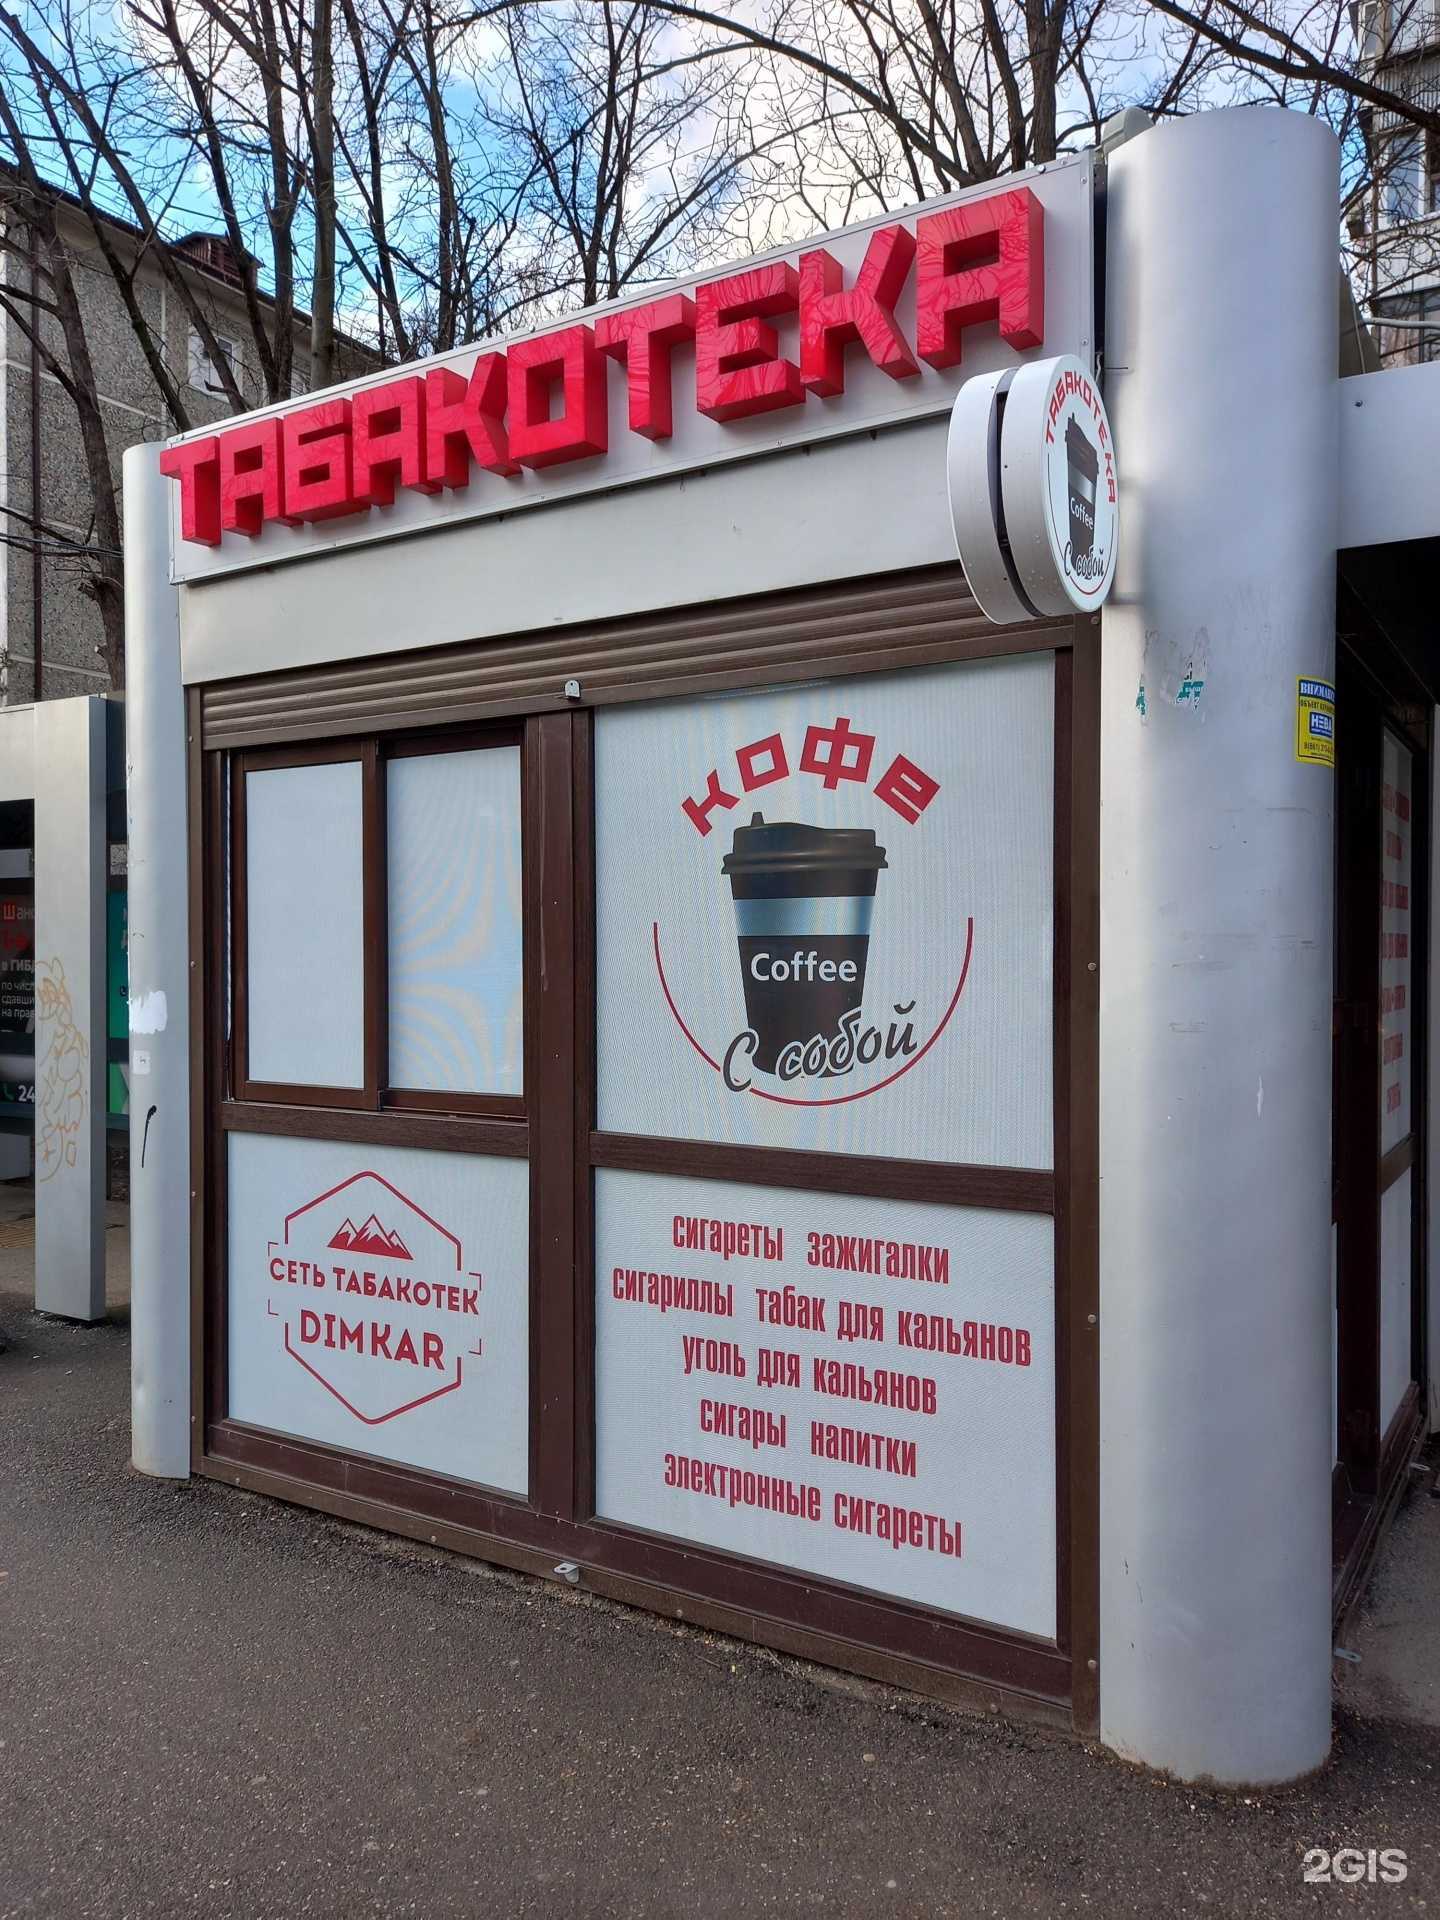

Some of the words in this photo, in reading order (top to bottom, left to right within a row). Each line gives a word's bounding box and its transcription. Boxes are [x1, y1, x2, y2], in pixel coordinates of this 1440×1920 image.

[160, 187, 1046, 547] ТАБАКОТЕКА
[1046, 370, 1116, 503] ТАБАКОТЕКА
[1070, 496, 1094, 531] Coffee
[1075, 543, 1104, 580] собой
[750, 951, 858, 982] Coffee
[723, 1031, 756, 1093] С
[777, 1000, 918, 1081] собой
[270, 1257, 326, 1288] СЕТЬ
[333, 1266, 479, 1315] ТАБАКОТЕК
[672, 1215, 784, 1262] сигареты
[807, 1231, 950, 1285] зажигалки
[300, 1308, 445, 1370] DIMKAR
[613, 1267, 734, 1318] сигариллы
[755, 1285, 826, 1332] табак
[837, 1301, 885, 1342] для
[898, 1310, 1032, 1367] кальянов
[682, 1335, 747, 1378] уголь
[757, 1348, 802, 1388] для
[813, 1357, 937, 1415] кальянов
[700, 1398, 787, 1450] сигары
[810, 1420, 917, 1477] напитки
[664, 1453, 822, 1522] электронные
[833, 1493, 962, 1558] сигареты
